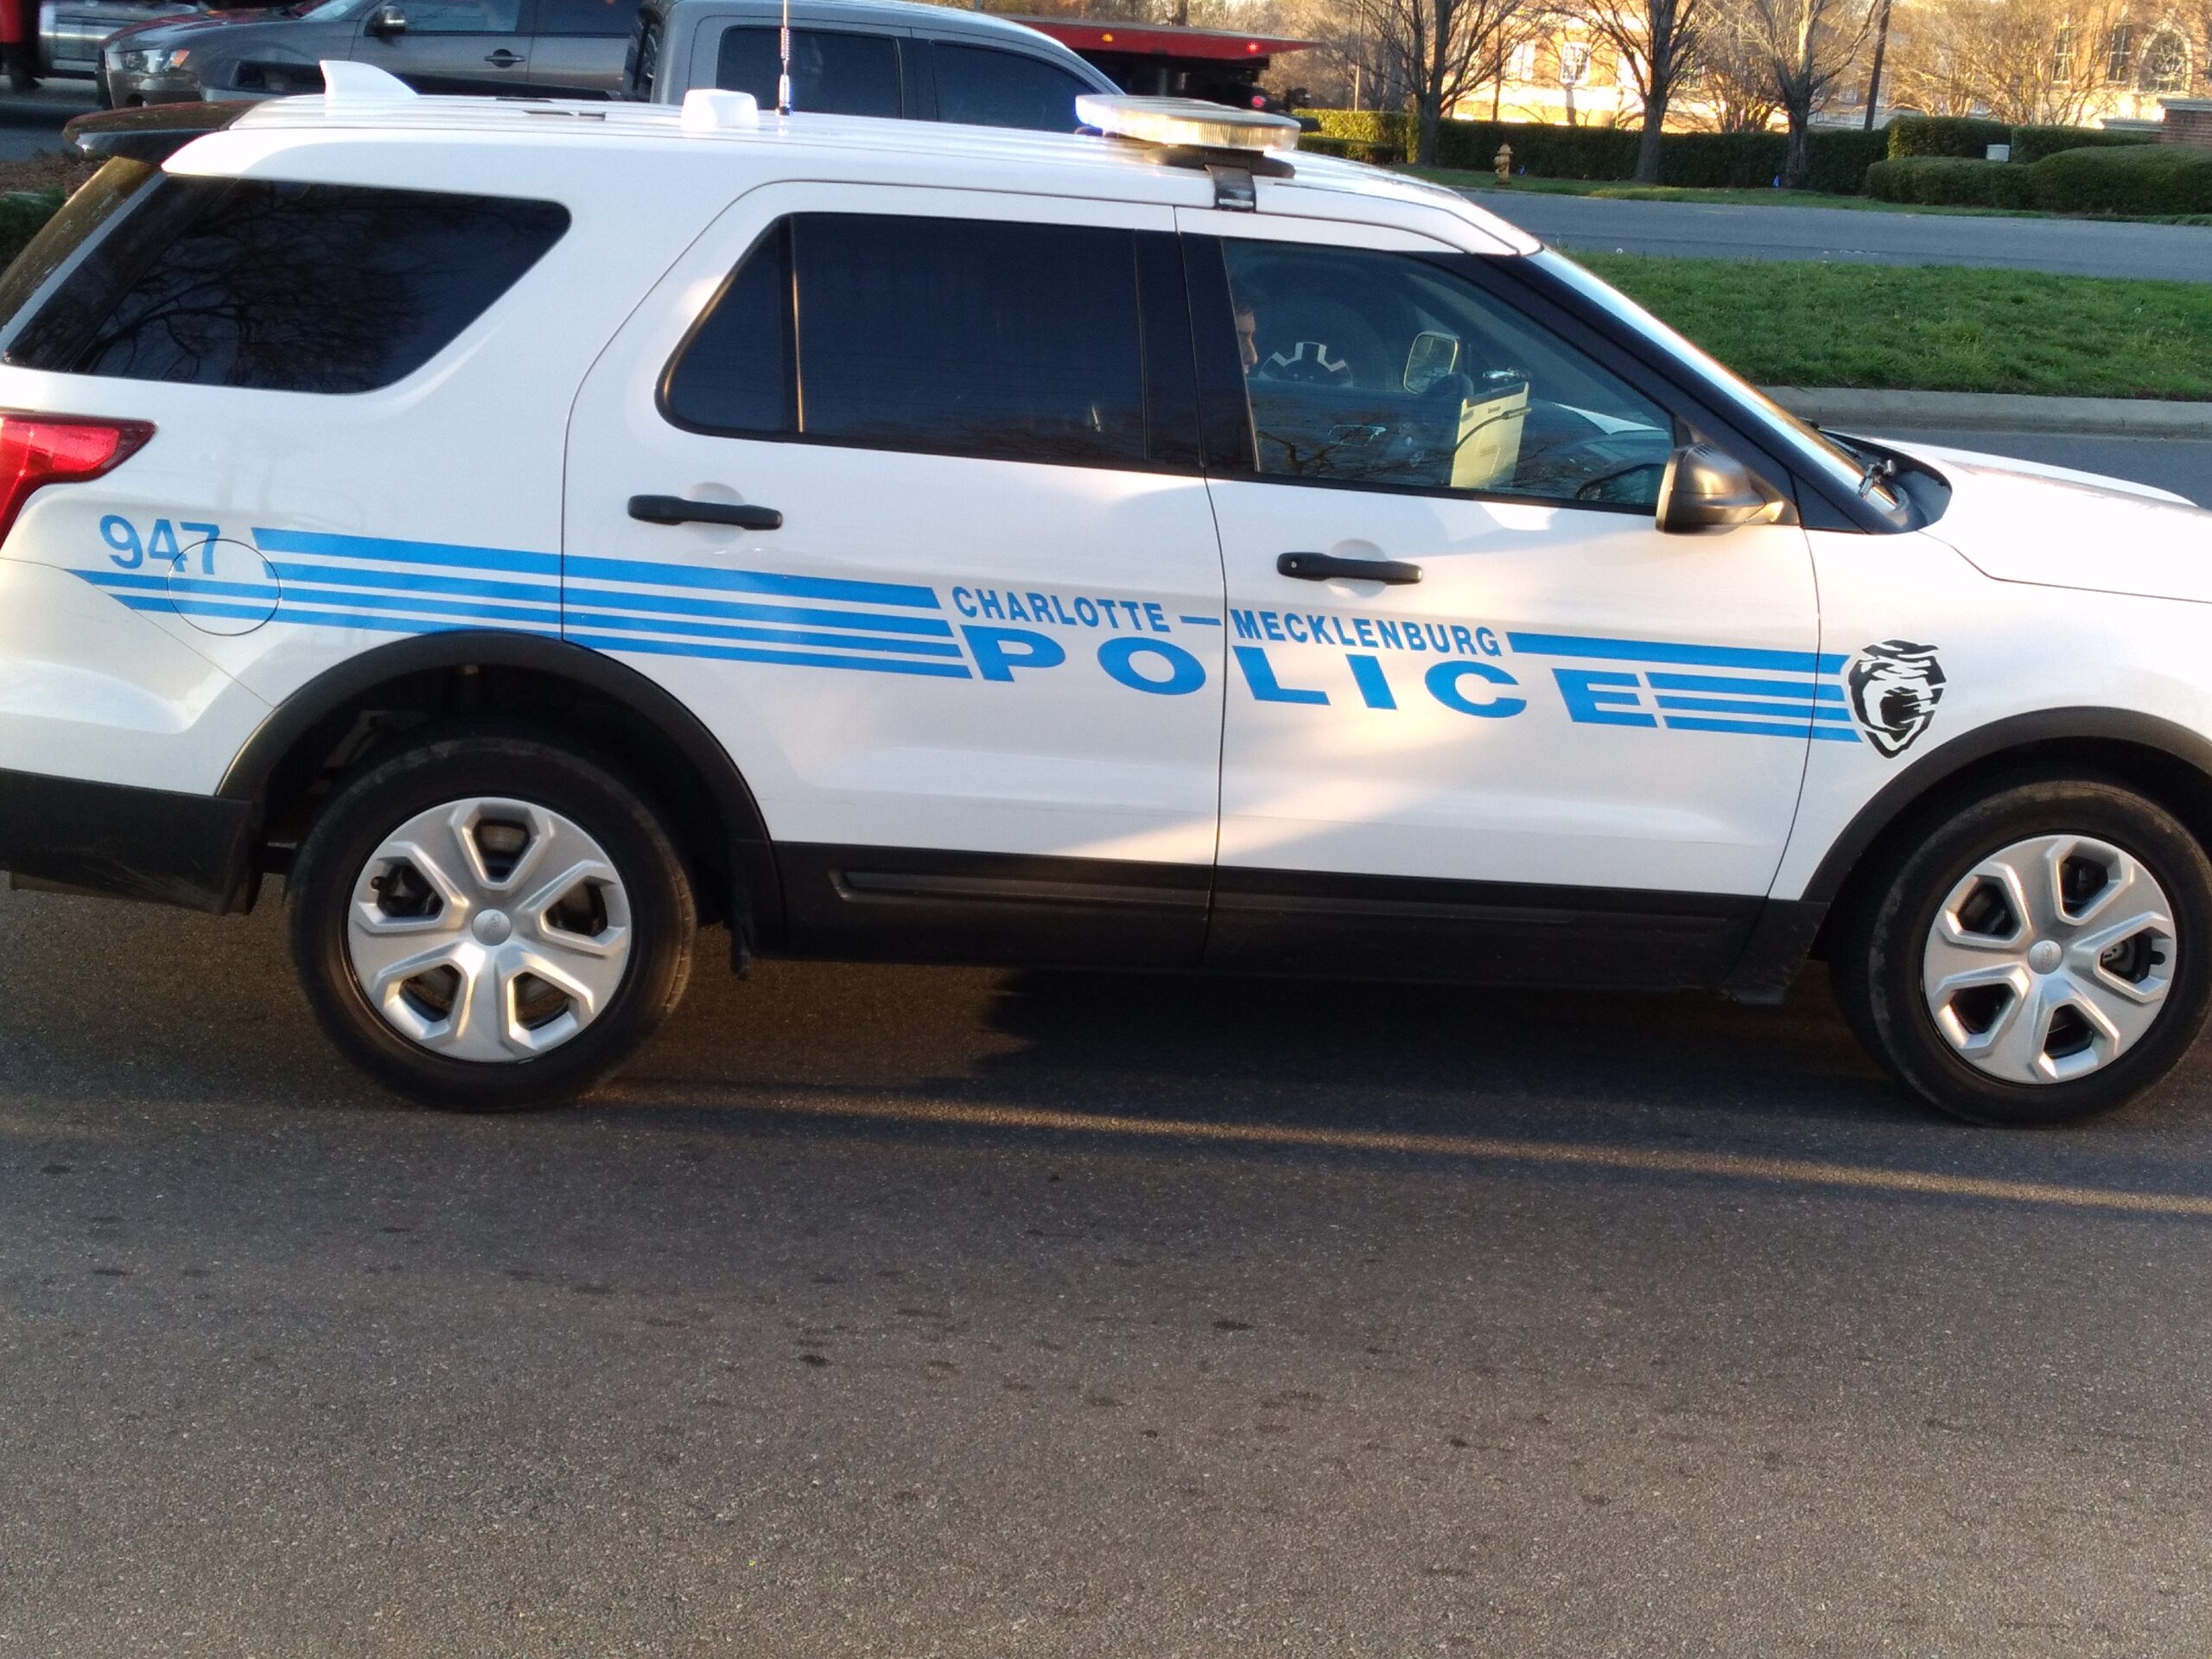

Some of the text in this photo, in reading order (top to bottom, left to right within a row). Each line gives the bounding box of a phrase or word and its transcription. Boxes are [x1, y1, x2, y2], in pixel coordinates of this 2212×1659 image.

[99, 514, 220, 575] 947
[951, 586, 1171, 632] CHARLOTTE
[1230, 608, 1503, 657] MECKLENBURG
[959, 624, 1659, 728] POLICE
